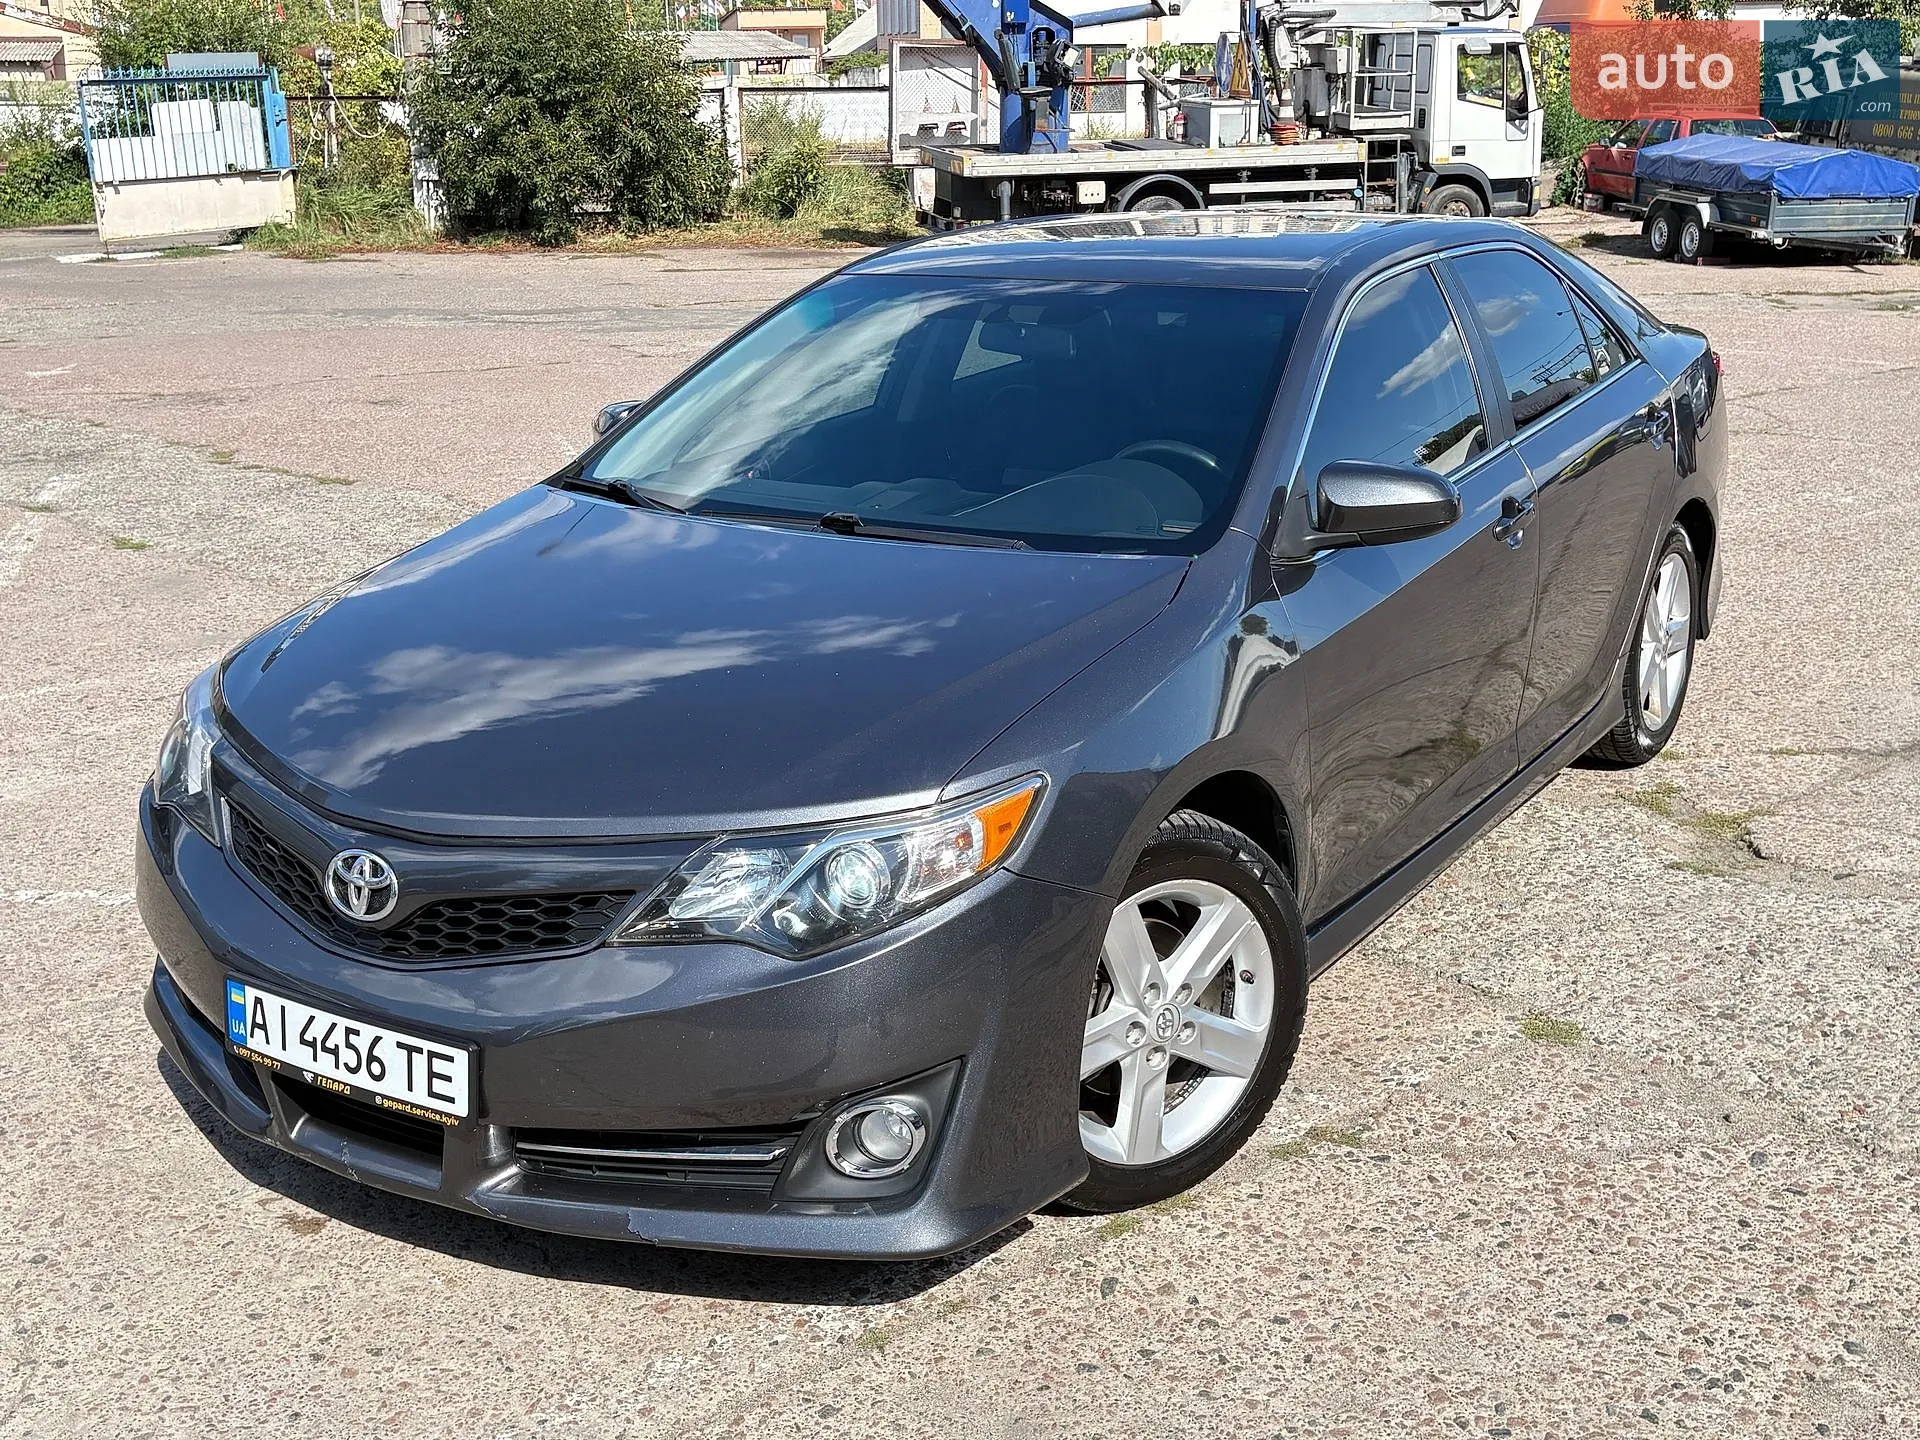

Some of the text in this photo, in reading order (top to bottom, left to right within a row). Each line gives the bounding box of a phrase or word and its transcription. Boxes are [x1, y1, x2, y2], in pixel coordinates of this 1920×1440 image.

[232, 1018, 247, 1037] UA
[249, 996, 456, 1104] AI 4456 TE
[316, 1076, 351, 1095] ГЕПАРД
